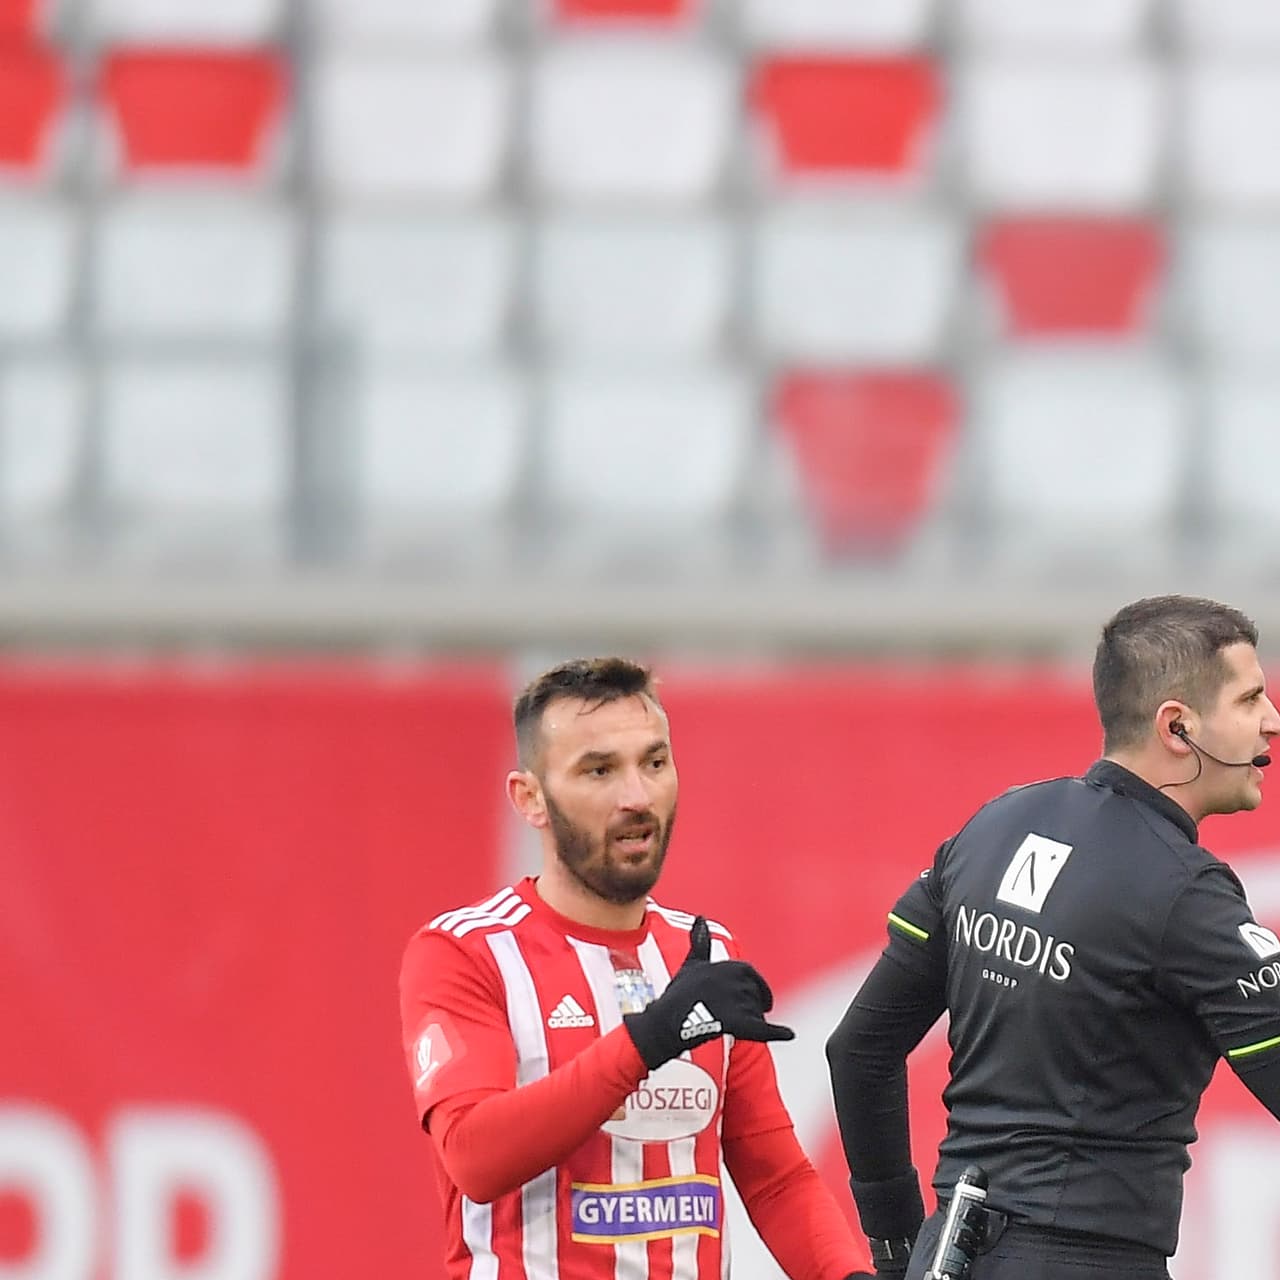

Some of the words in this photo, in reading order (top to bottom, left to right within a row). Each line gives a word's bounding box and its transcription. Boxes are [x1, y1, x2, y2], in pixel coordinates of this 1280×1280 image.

[955, 905, 1075, 981] NORDIS
[982, 969, 1018, 989] GROUP
[548, 1014, 595, 1029] adidas
[680, 1020, 723, 1041] adidas
[629, 1081, 712, 1110] IÓSZEGI
[578, 1195, 714, 1225] GYERMELYI
